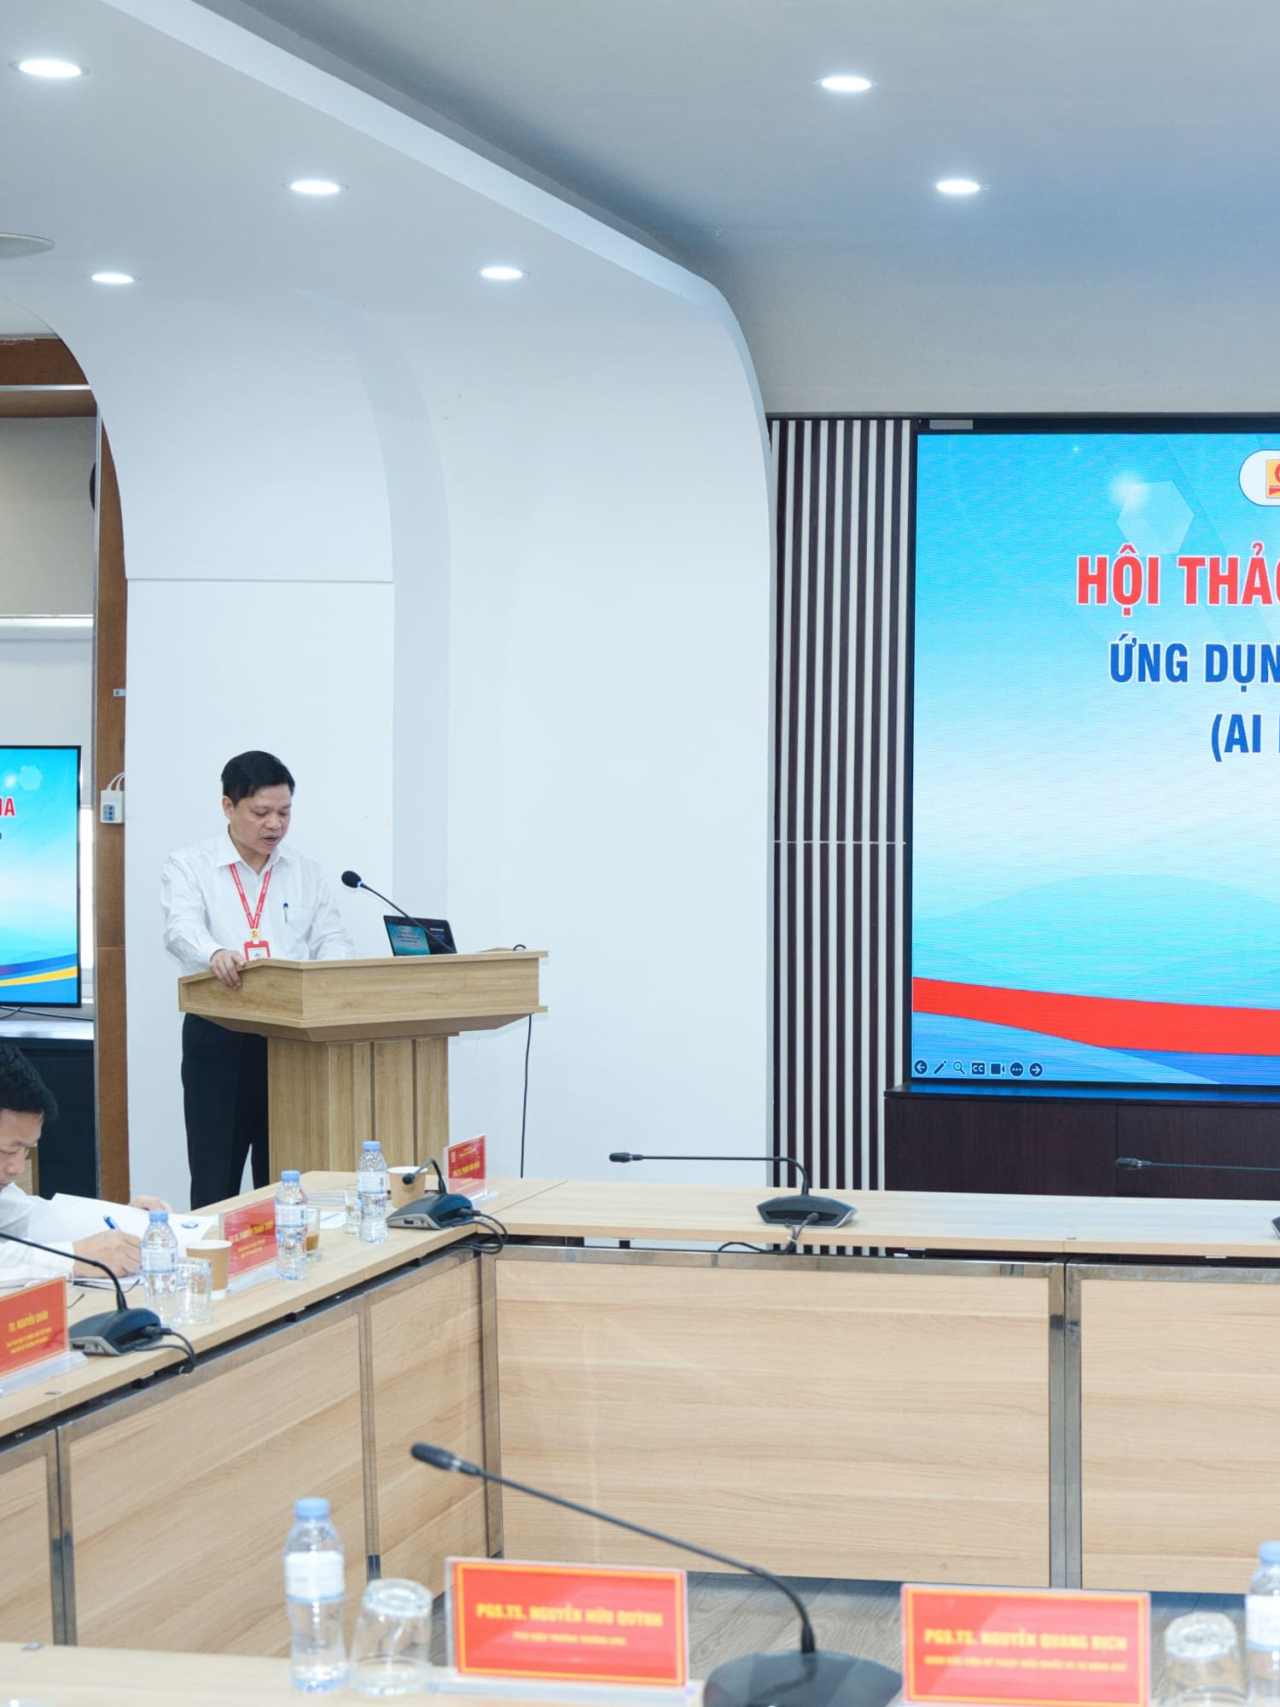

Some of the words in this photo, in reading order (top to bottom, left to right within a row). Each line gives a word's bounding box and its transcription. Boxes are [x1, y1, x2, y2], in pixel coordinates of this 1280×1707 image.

[1078, 545, 1159, 616] HỘI
[1110, 633, 1188, 683] ỨNG
[1211, 713, 1262, 762] (AI
